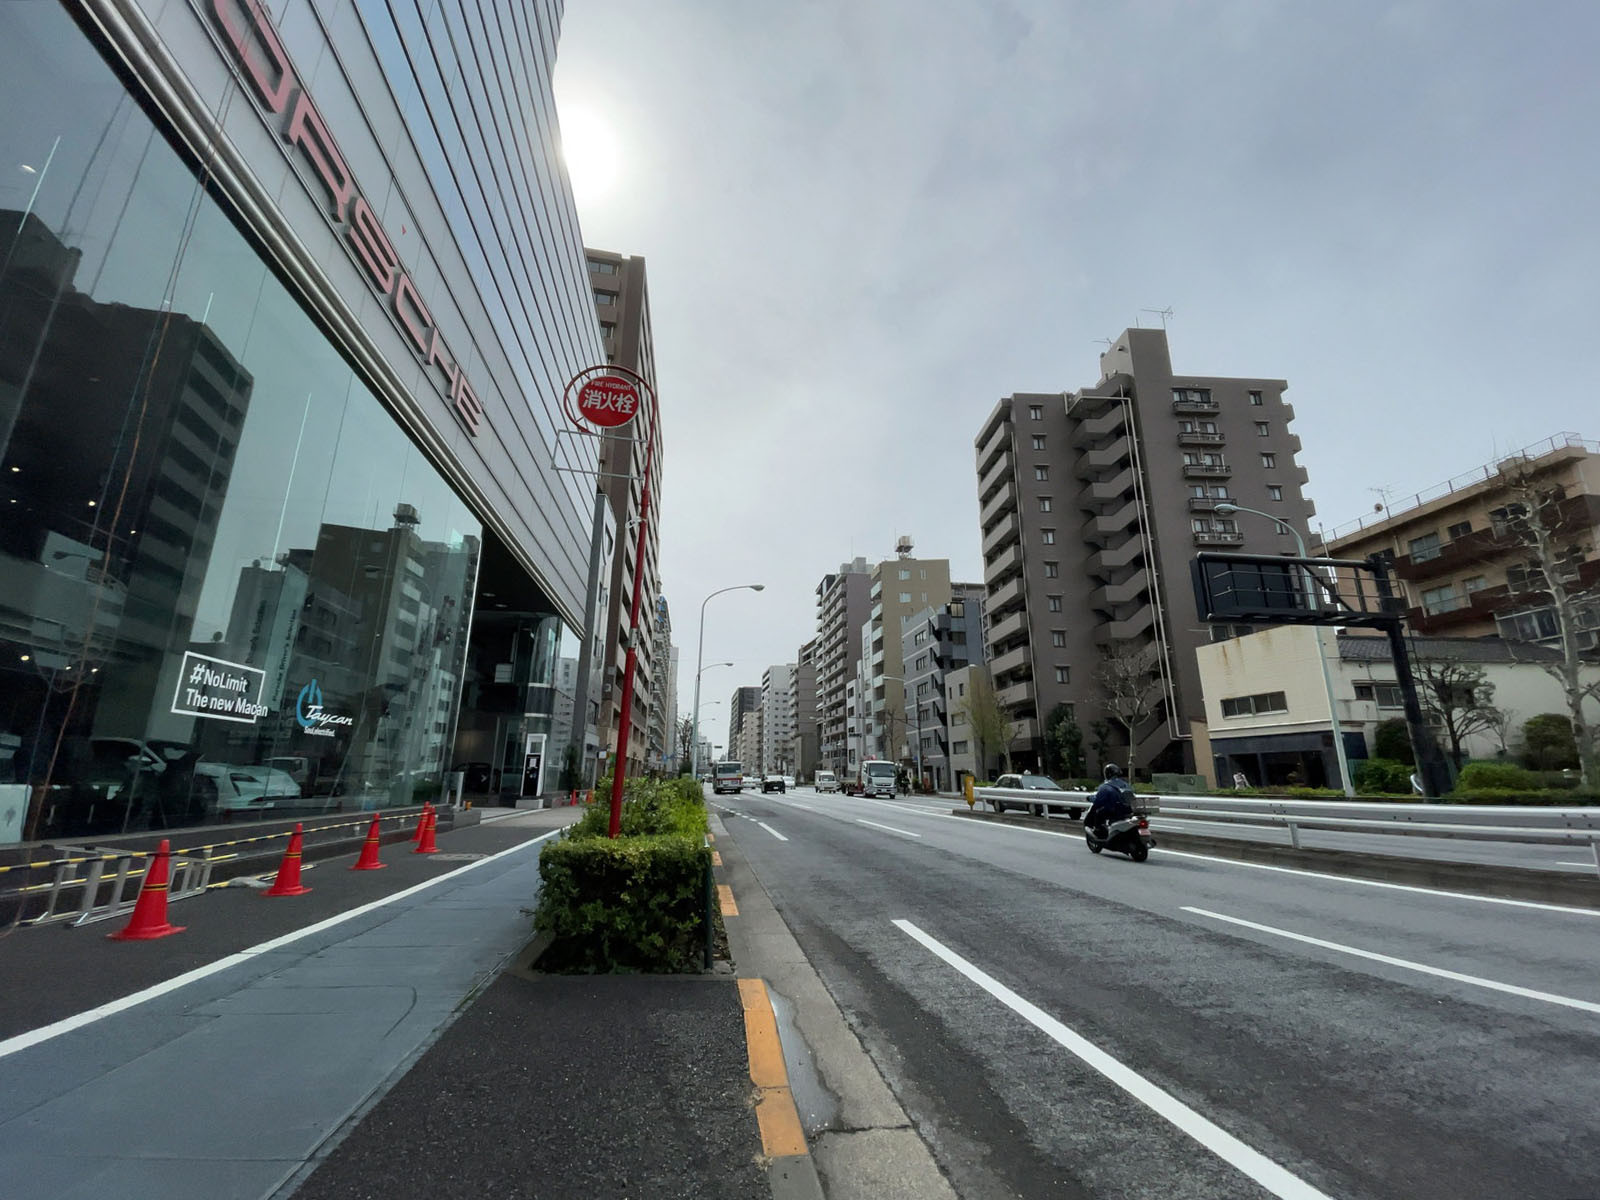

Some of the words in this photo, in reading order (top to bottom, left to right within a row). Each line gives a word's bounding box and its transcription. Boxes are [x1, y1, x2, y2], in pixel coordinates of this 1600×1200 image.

[582, 389, 635, 413] 消火栓
[190, 663, 248, 693] #NoLimit
[185, 688, 209, 708] The
[209, 698, 234, 710] new
[235, 698, 269, 717] Macan
[305, 704, 353, 727] Taycan
